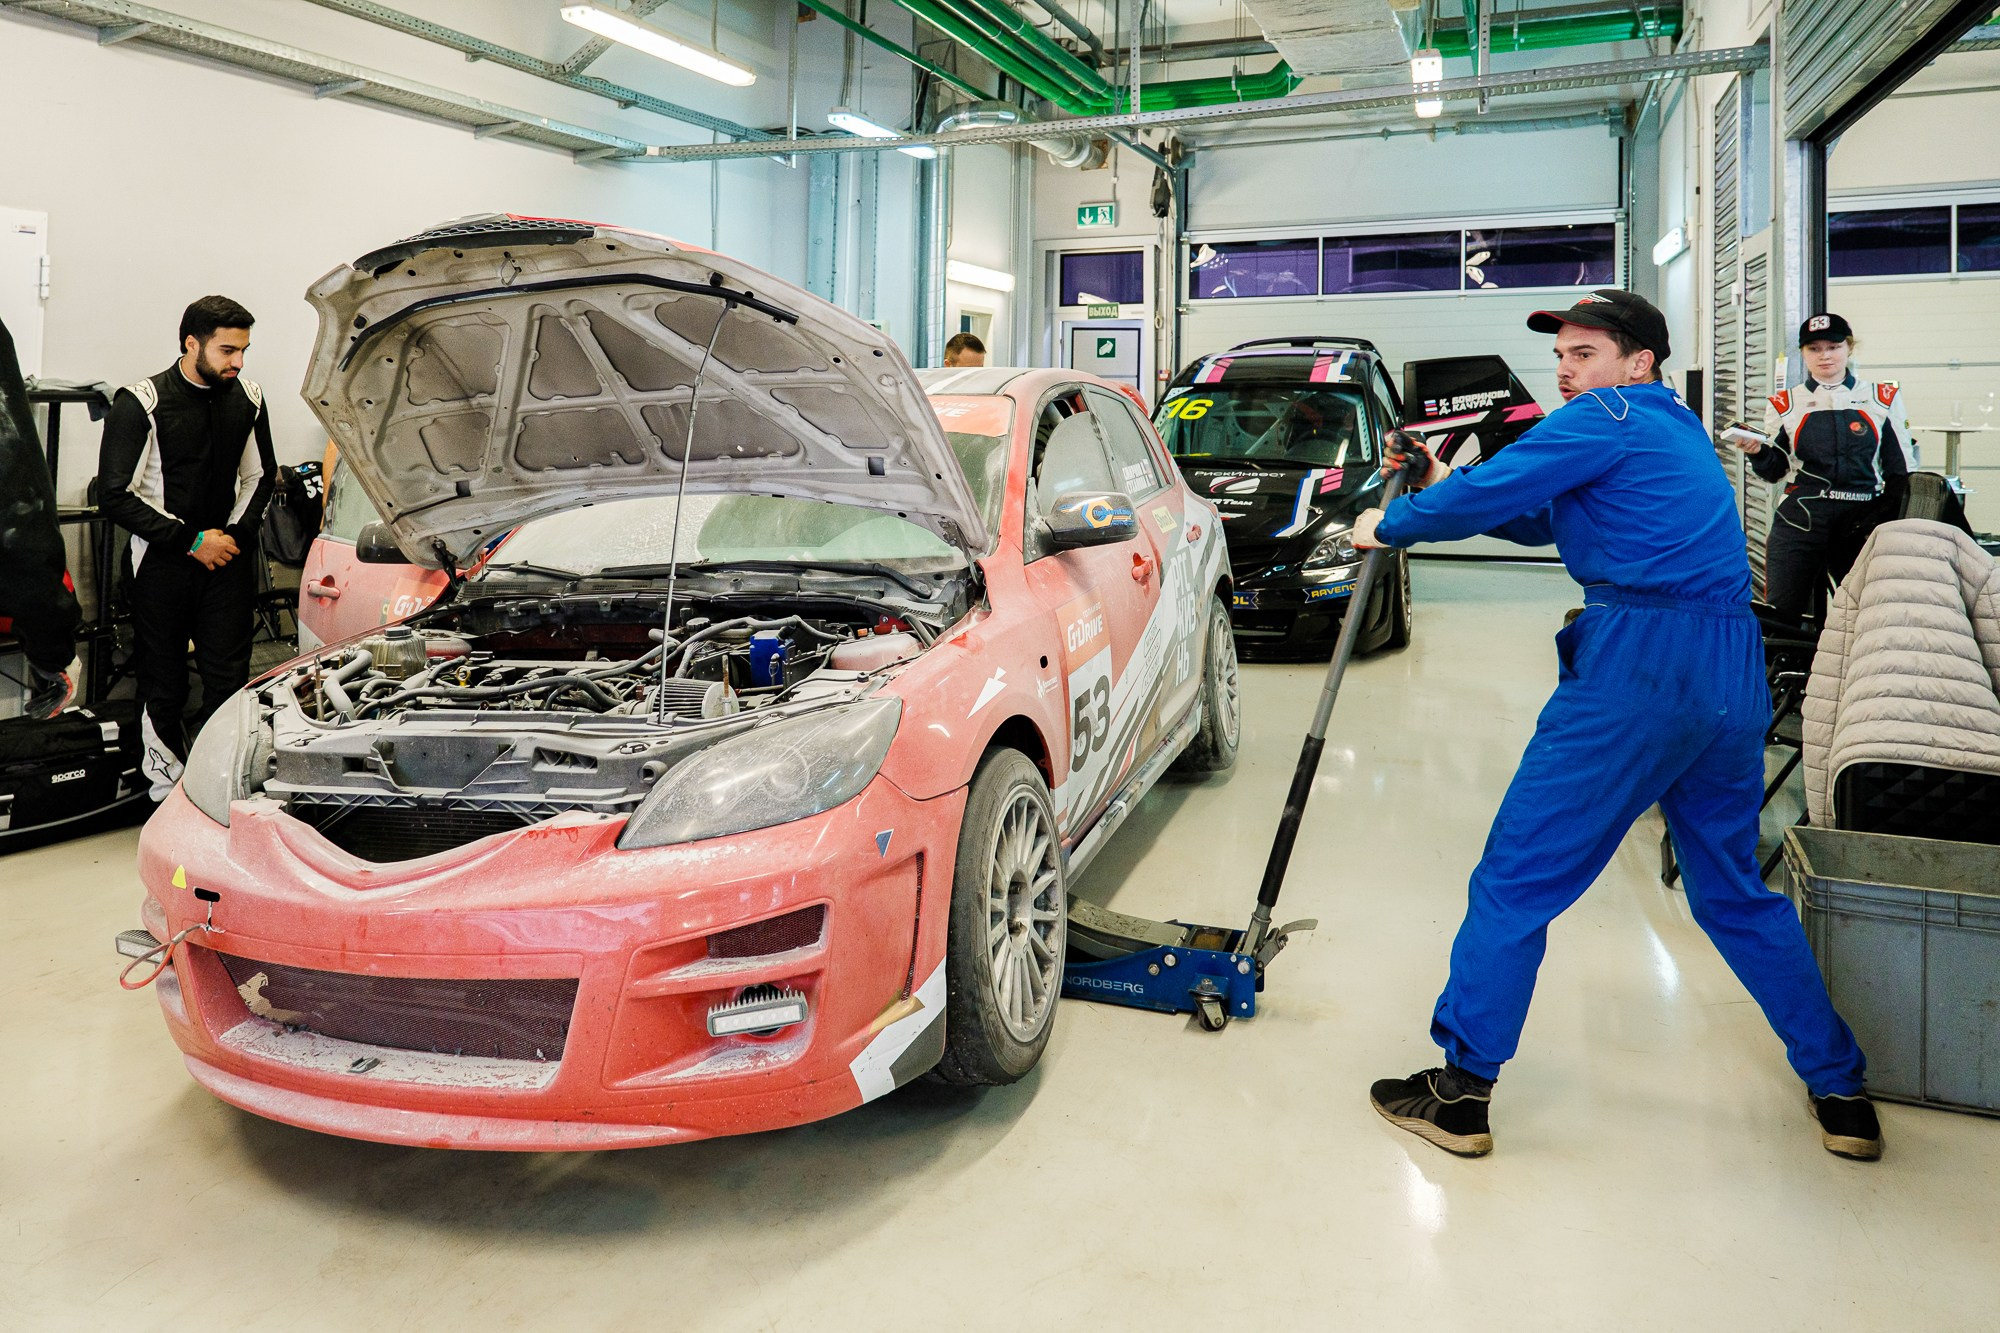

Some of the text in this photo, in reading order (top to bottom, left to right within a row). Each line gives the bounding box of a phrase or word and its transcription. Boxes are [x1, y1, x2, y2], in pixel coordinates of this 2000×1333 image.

[1088, 306, 1118, 317] ВЫХОД
[1810, 315, 1829, 331] 53
[1451, 389, 1511, 405] БОЯРИНОВА
[1167, 397, 1214, 420] 16
[1452, 398, 1494, 412] КАЧУРА
[1829, 490, 1872, 501] SUKHANOVA
[1311, 583, 1357, 598] RAVENO
[1072, 675, 1110, 773] 53
[51, 769, 86, 784] sparco
[1062, 976, 1144, 993] NORDBERG
